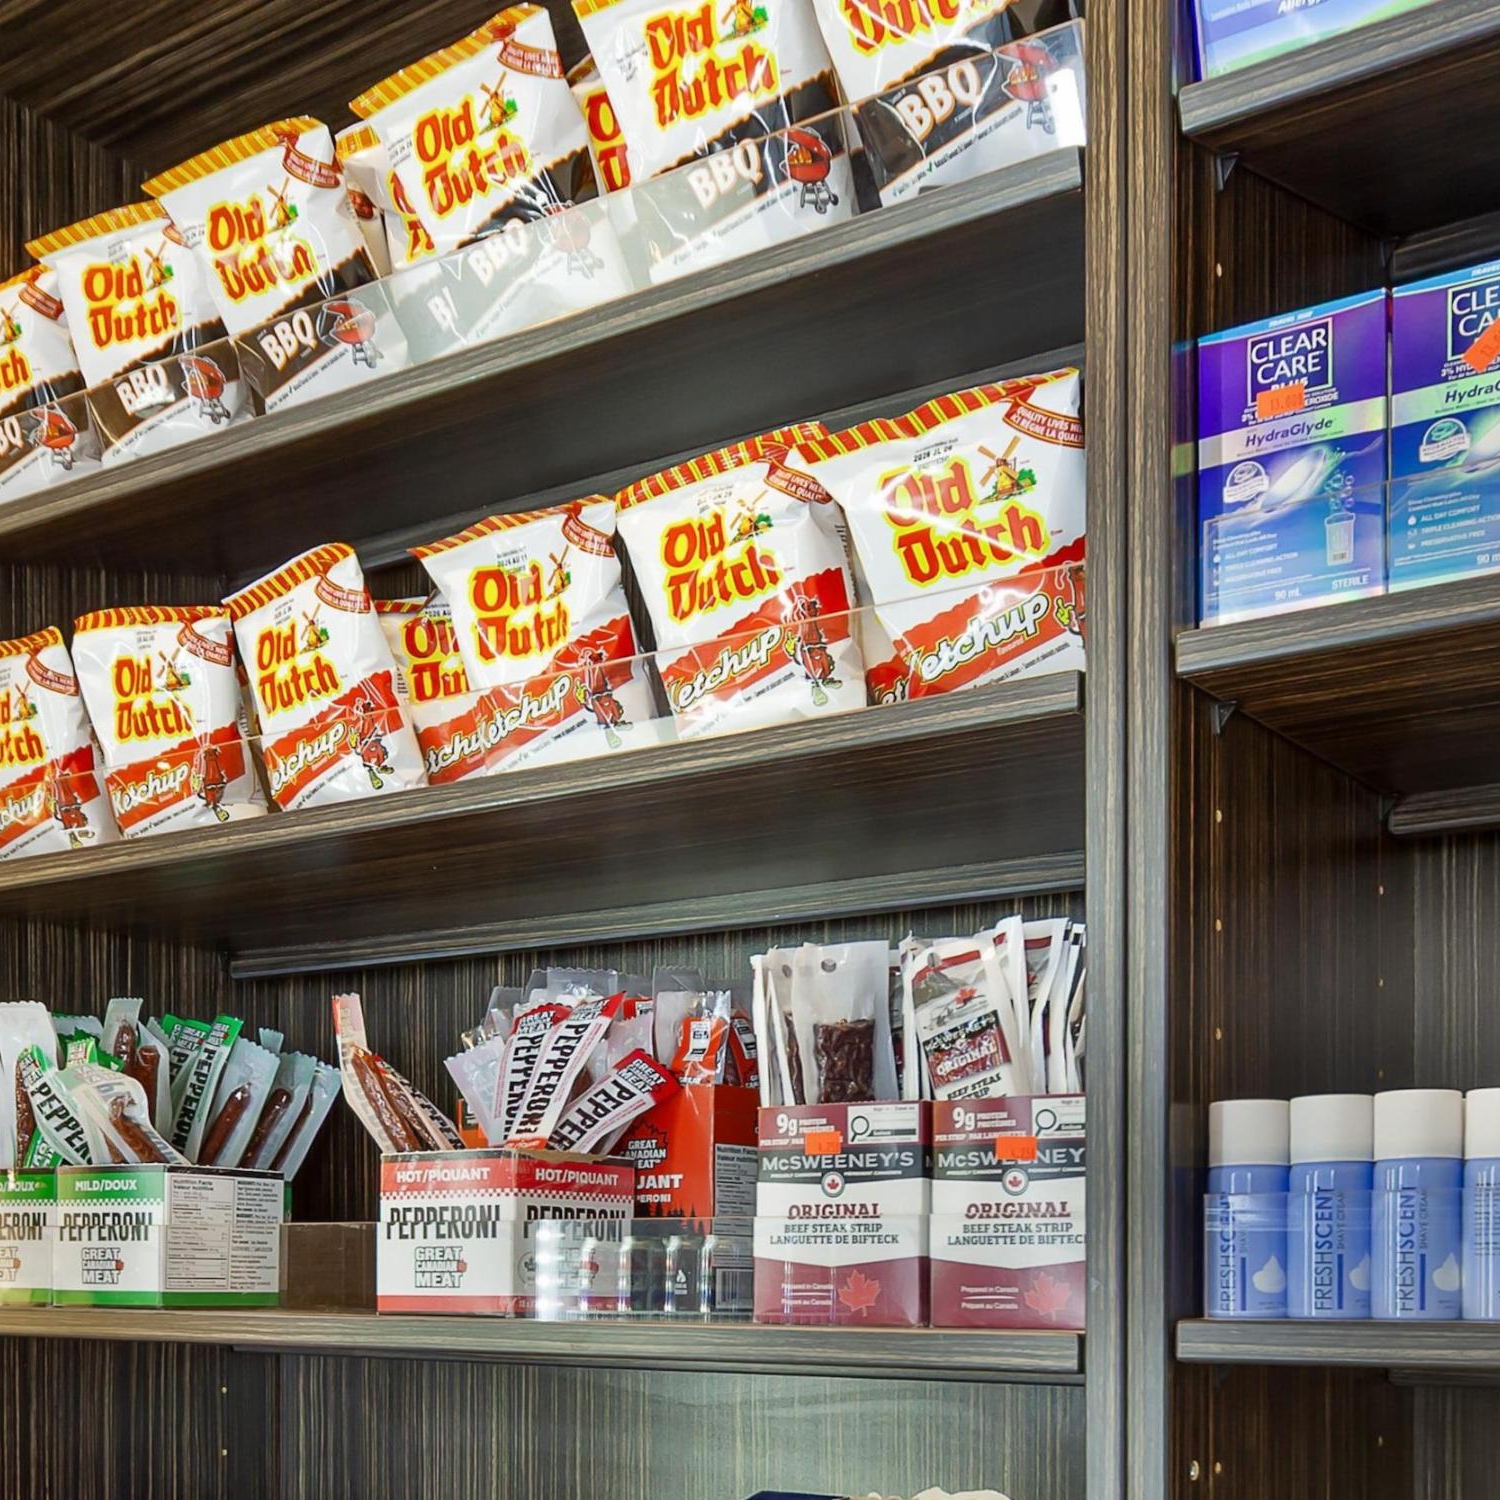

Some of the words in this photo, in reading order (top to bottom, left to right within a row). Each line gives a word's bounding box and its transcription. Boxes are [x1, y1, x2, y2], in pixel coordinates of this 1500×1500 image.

[647, 4, 714, 70] Old
[655, 45, 775, 126] Dutch
[896, 61, 982, 142] BBQ
[417, 99, 476, 163] Old
[425, 134, 528, 215] Dutch
[688, 138, 763, 210] BBQ
[208, 199, 265, 251] Old
[84, 262, 143, 300] Old
[214, 242, 315, 300] Dutch
[90, 297, 178, 347] Dutch
[260, 312, 315, 371] BBQ
[1250, 327, 1328, 365] CLEAR
[1257, 351, 1323, 384] CARE
[117, 364, 171, 416] BBQ
[1244, 417, 1334, 448] HydraGlyde
[881, 461, 973, 527] Old
[663, 511, 726, 569] Old
[898, 506, 1044, 584] Dutch
[1477, 553, 1491, 565] 90
[473, 564, 543, 612] Old
[668, 545, 780, 621] Dutch
[1332, 574, 1370, 590] STERILE
[257, 621, 298, 671] Old
[476, 600, 568, 662] Dutch
[908, 594, 1050, 682] etchup
[114, 658, 152, 698] Old
[259, 656, 340, 714] Dutch
[670, 626, 783, 711] etchup
[116, 698, 192, 739] Dutch
[484, 676, 573, 746] etchup
[271, 722, 347, 796] etchup
[776, 1112, 799, 1137] 9g
[952, 1106, 976, 1131] 9g
[628, 1139, 658, 1150] GREAT
[762, 1151, 915, 1171] McSWEENEY'S
[75, 1179, 137, 1192] MILD/DOUX
[396, 1167, 491, 1184] HOT/PIQUANT
[535, 1168, 620, 1187] HOT/PIQUANT
[59, 1212, 153, 1242] PEPPERONI
[386, 1204, 500, 1240] PEPPERONI
[784, 1223, 809, 1234] BEEF
[812, 1223, 847, 1234] STEAK
[850, 1223, 883, 1233] STRIP
[787, 1202, 881, 1220] ORIGINAL
[963, 1223, 990, 1235] BEEF
[993, 1223, 1032, 1235] STEAK
[1035, 1222, 1073, 1233] STRIP
[964, 1201, 1072, 1219] ORIGINAL
[81, 1247, 121, 1260] GREAT
[415, 1246, 463, 1261] GREAT
[770, 1234, 833, 1245] LANGUETTE
[835, 1234, 849, 1245] DE
[851, 1234, 900, 1245] BIFTECK
[948, 1235, 1017, 1246] LANGUETTE
[1019, 1234, 1035, 1245] DE
[1314, 1185, 1335, 1311] FRESHSCENT
[1396, 1185, 1417, 1312] FRESHSCENT
[81, 1271, 120, 1284] MEAT
[415, 1272, 463, 1288] MEAT
